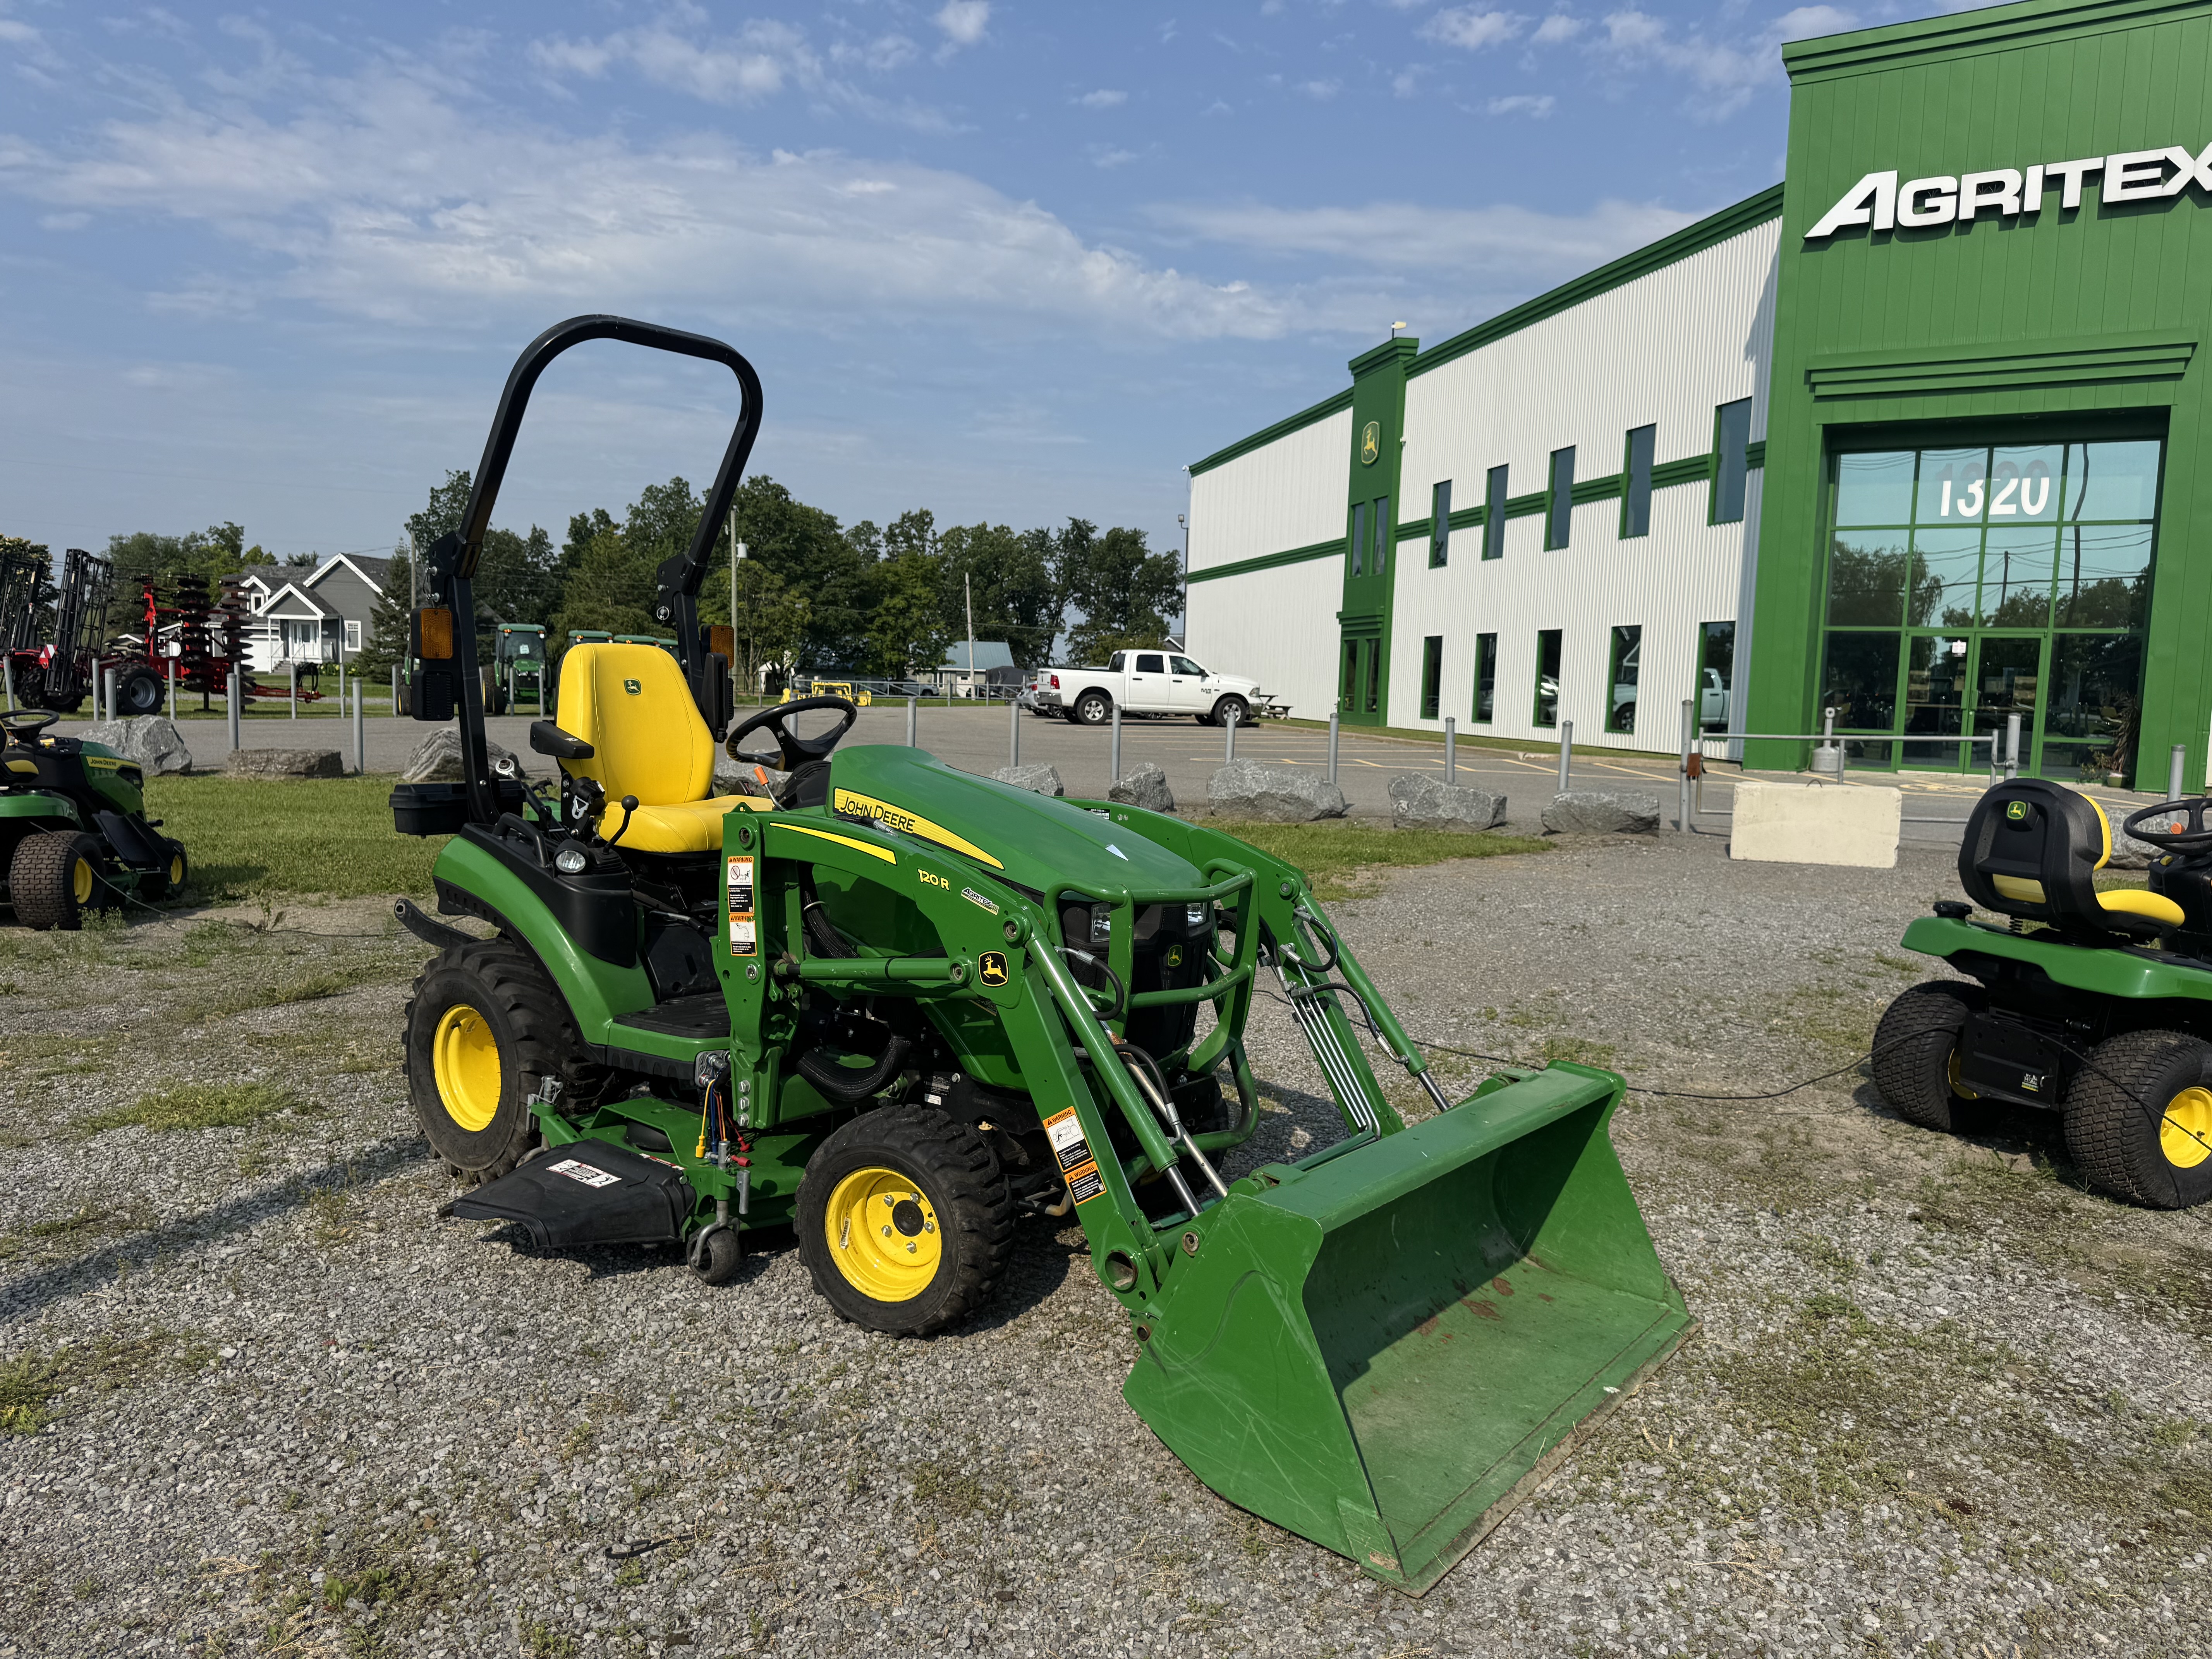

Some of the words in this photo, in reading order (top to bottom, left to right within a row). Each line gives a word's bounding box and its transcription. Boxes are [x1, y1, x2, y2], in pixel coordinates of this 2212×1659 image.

[1803, 141, 2212, 238] AGRITEX
[1936, 459, 2050, 517] 1320
[840, 796, 872, 817] JOHN
[874, 805, 915, 832] DEERE
[963, 888, 991, 906] AGRITEX
[1052, 1109, 1072, 1123] WARNING
[1074, 1165, 1094, 1178] WARNING
